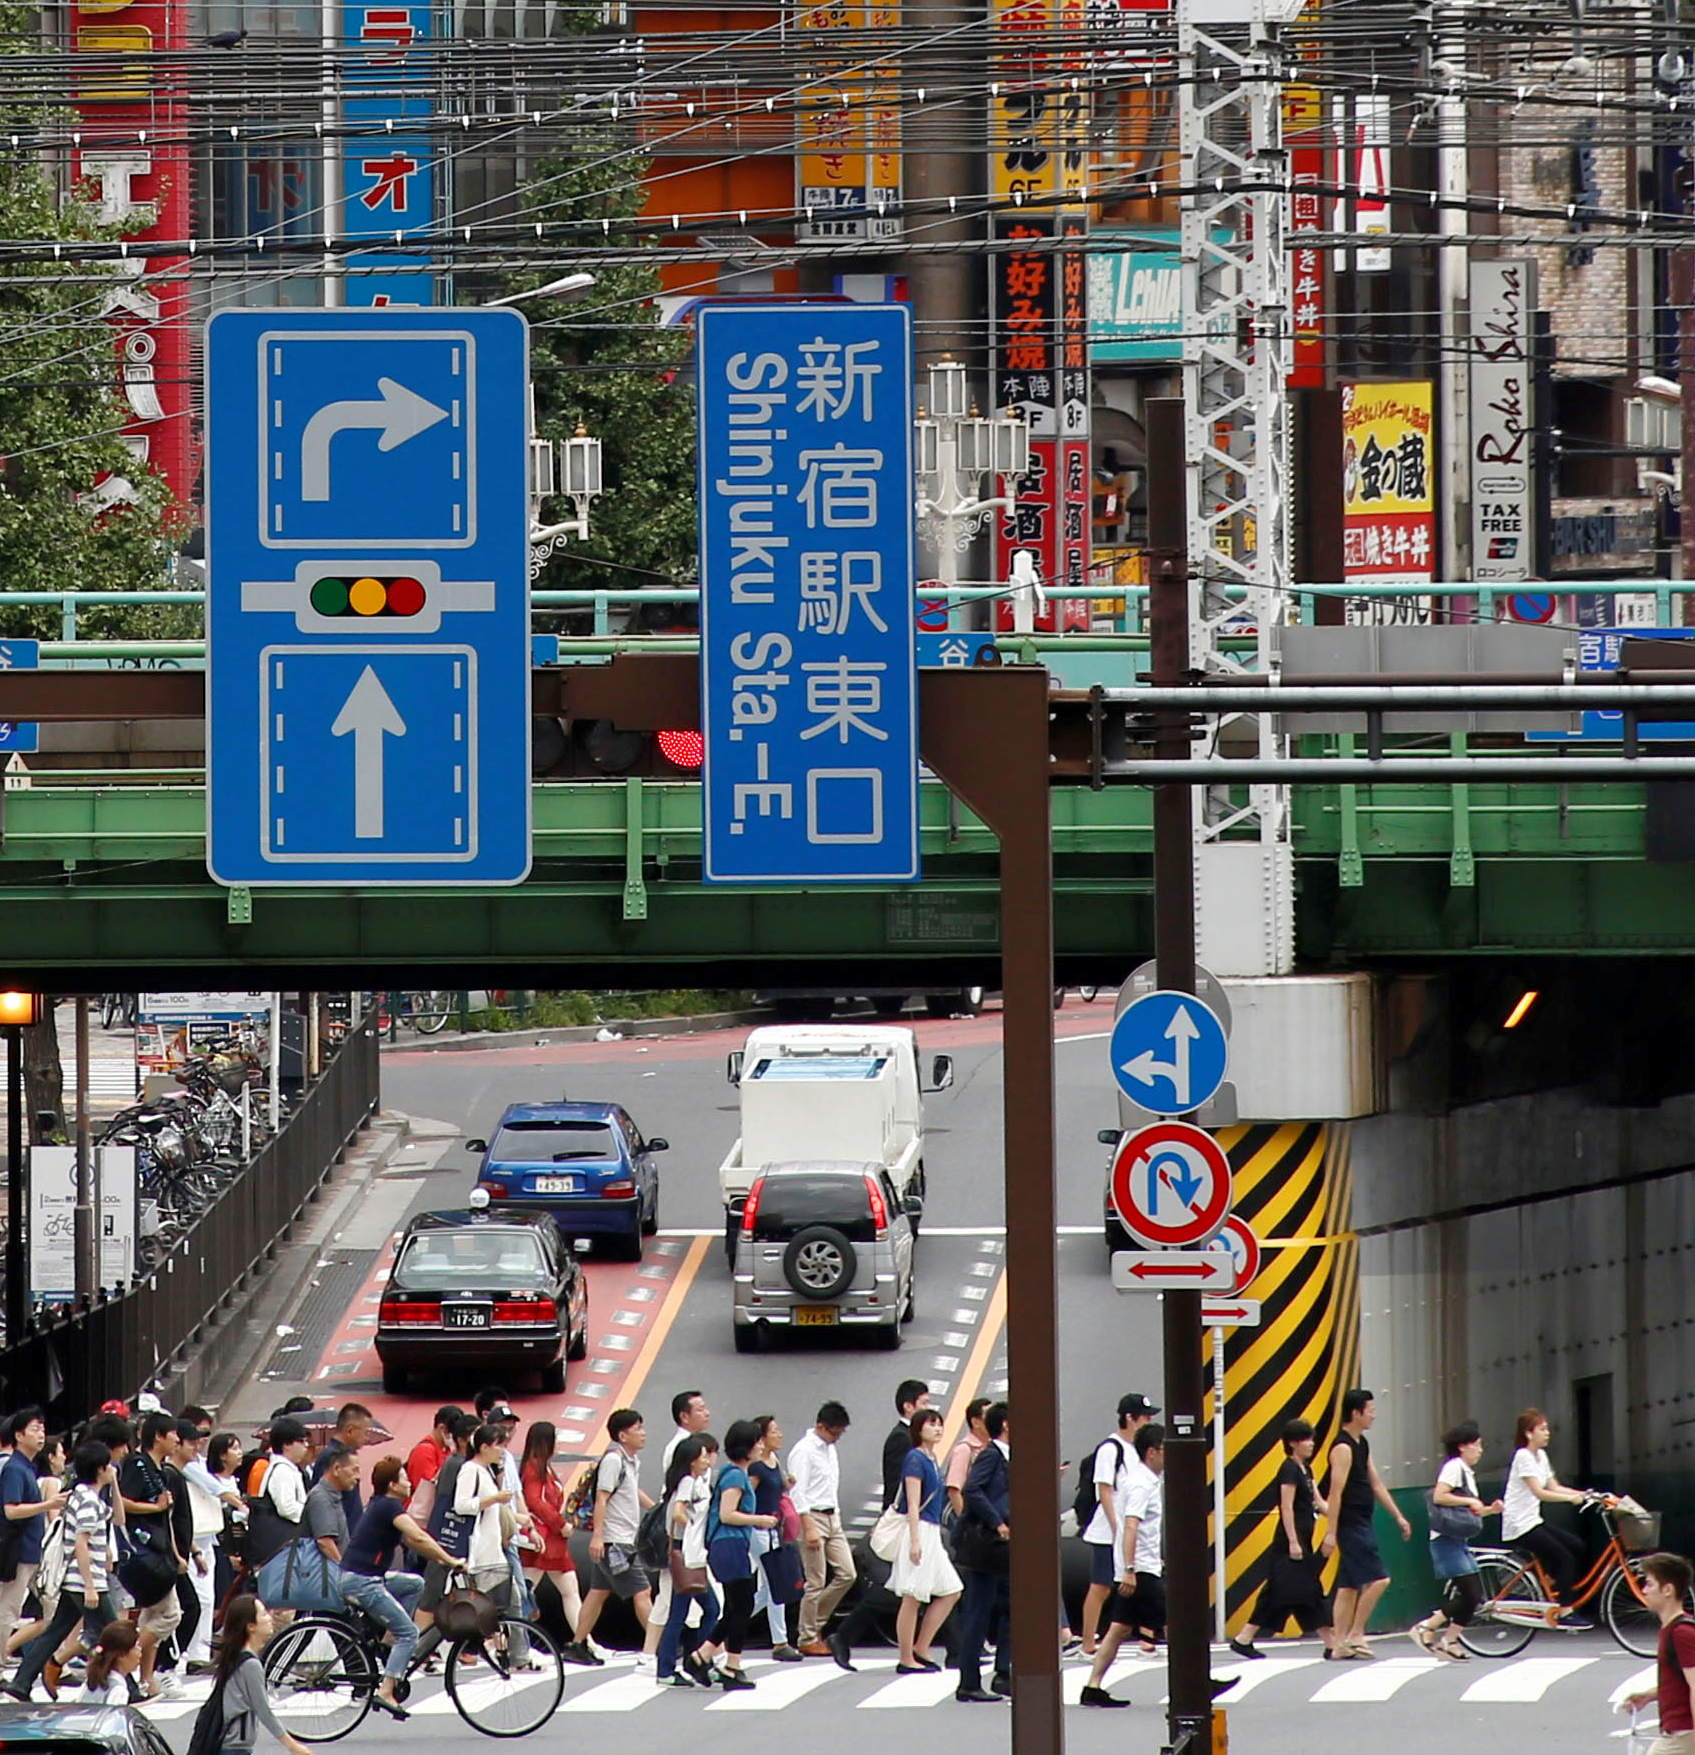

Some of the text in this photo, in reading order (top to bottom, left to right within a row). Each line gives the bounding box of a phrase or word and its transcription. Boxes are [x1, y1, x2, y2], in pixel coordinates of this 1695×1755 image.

[1003, 374, 1051, 399] 本陣
[1360, 433, 1426, 500] 金の蔵
[1480, 504, 1521, 517] TAX
[1480, 519, 1522, 532] FREE
[716, 351, 793, 836] Shinjuku Sta.-E.
[796, 335, 889, 845] 新宿駅東口
[456, 1314, 485, 1325] 17-20
